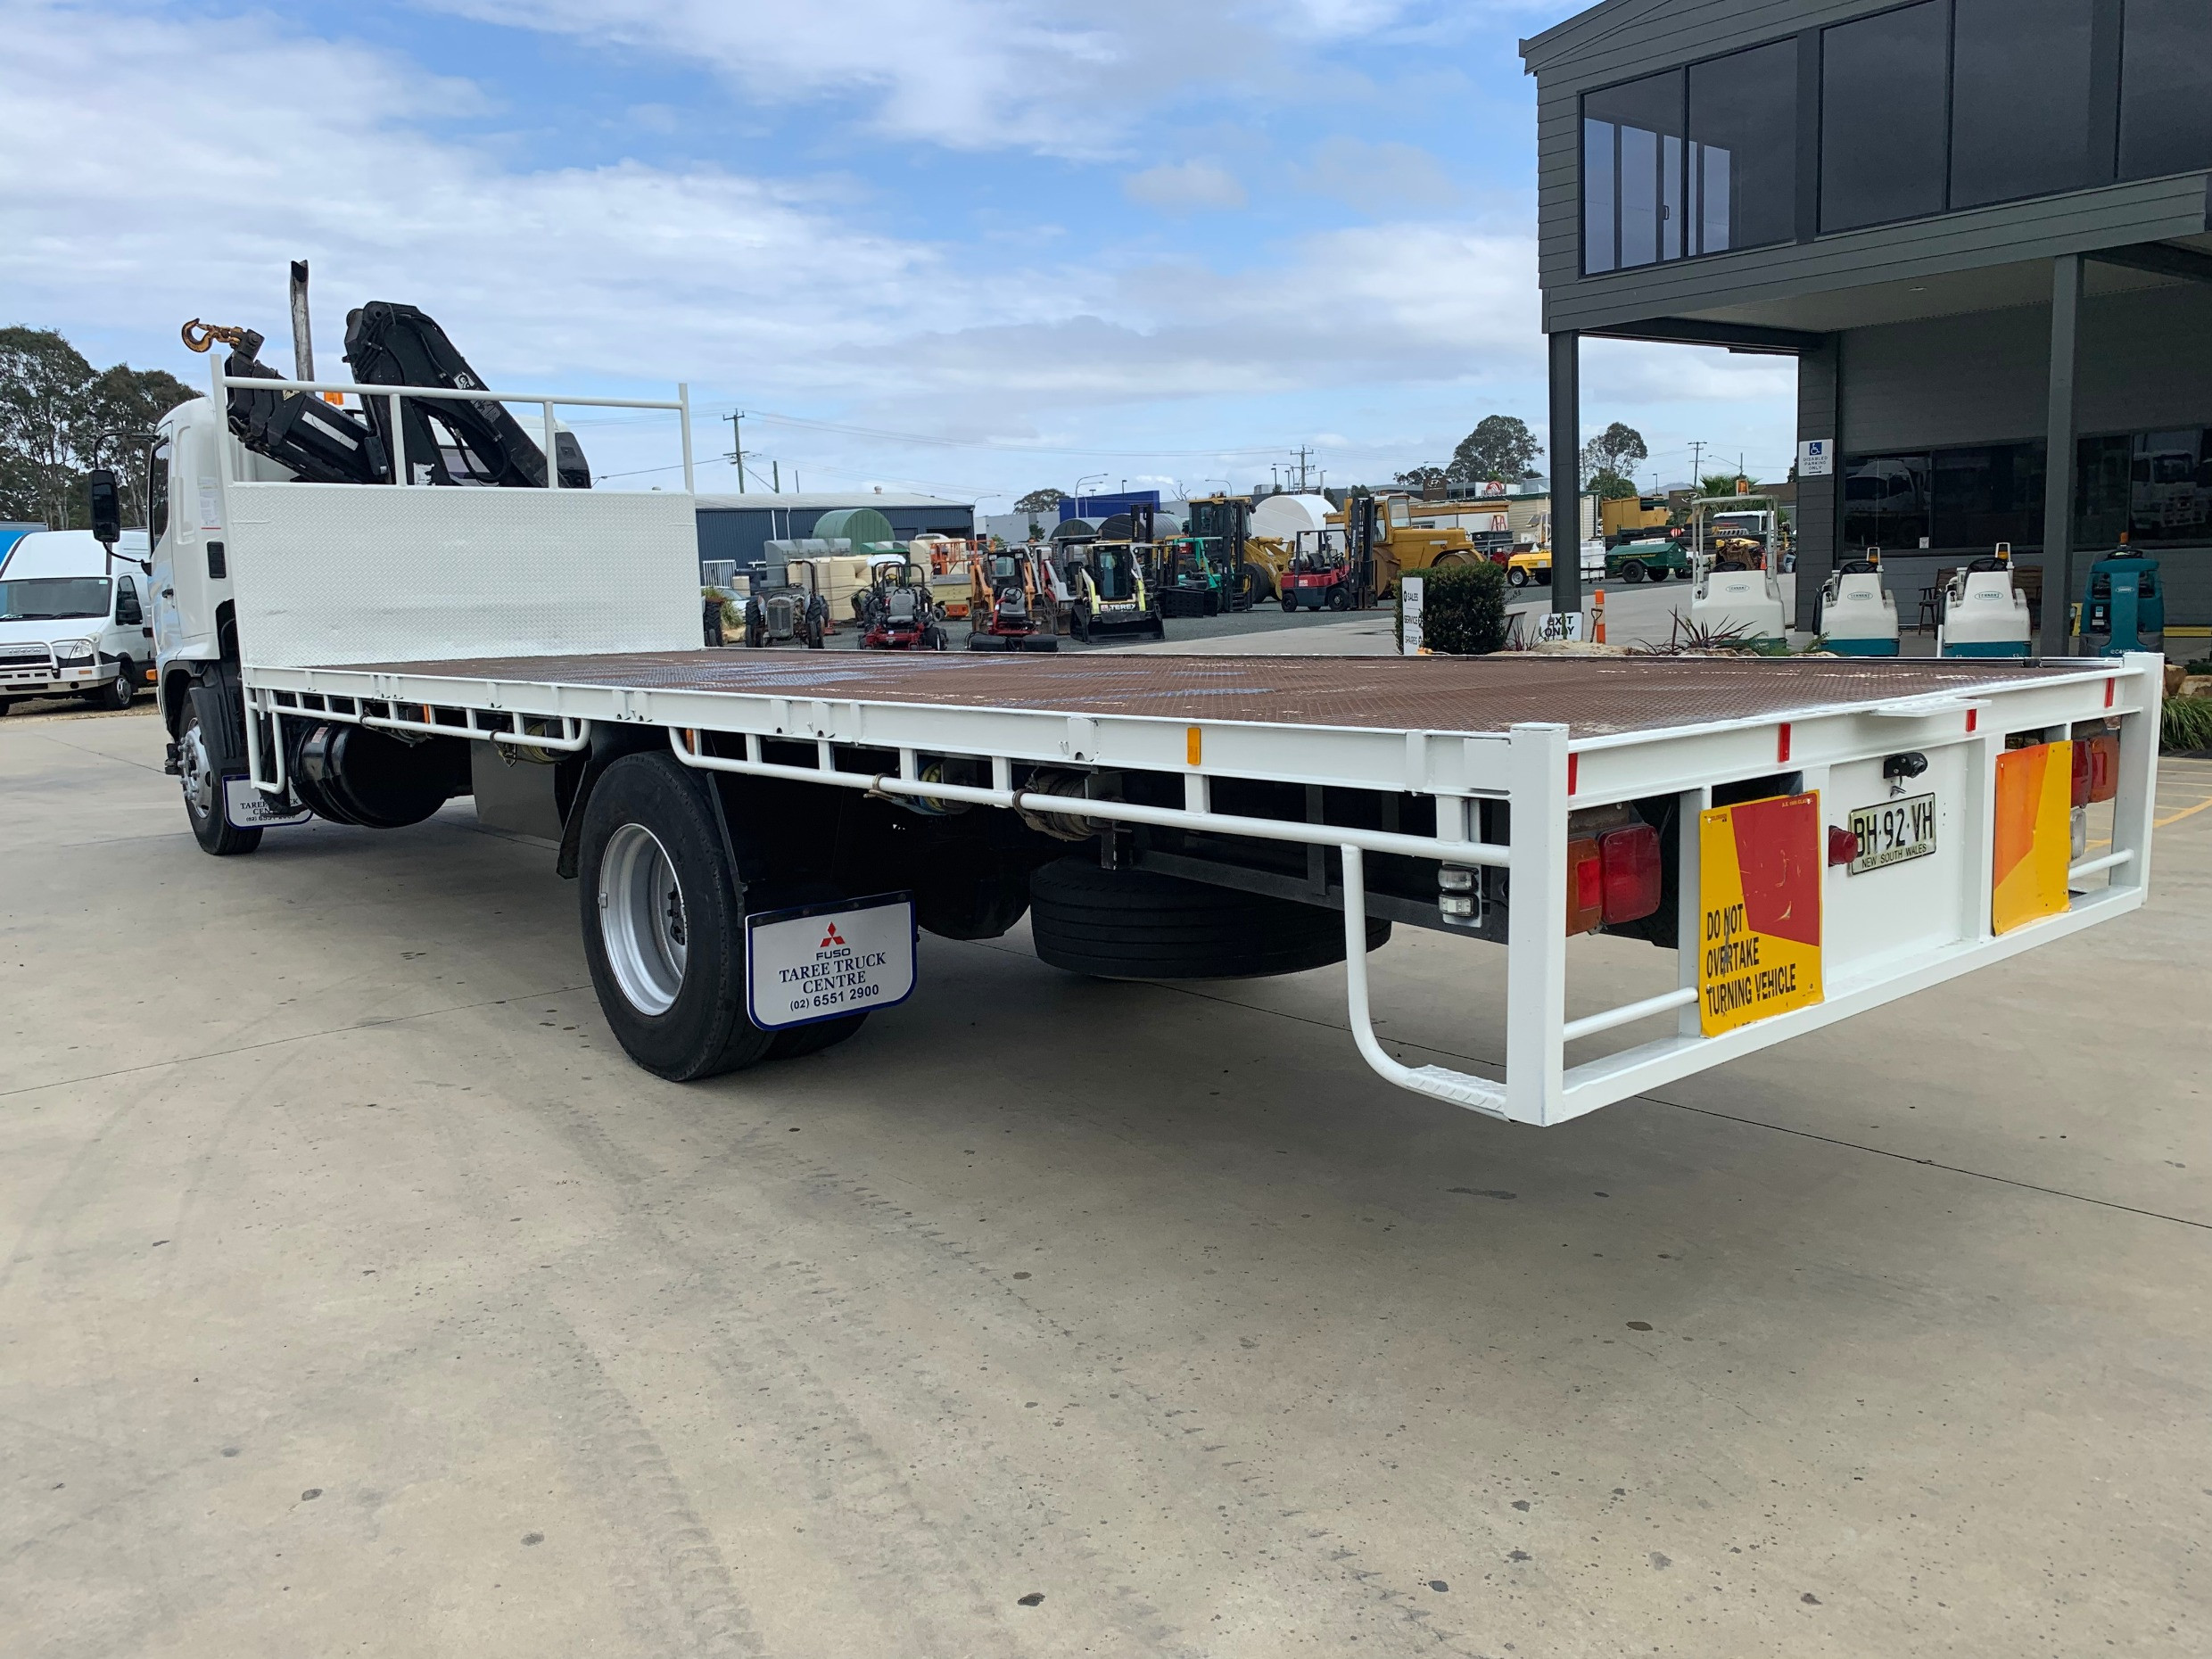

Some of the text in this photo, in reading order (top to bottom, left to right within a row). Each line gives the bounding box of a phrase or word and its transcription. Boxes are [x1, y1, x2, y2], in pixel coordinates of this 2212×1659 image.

[1407, 592, 1418, 601] SALES
[1109, 603, 1136, 611] TEREX
[1404, 615, 1418, 624] SERVICE
[1548, 615, 1573, 625] XT
[1405, 635, 1417, 645] SPARES
[1545, 626, 1574, 637] ONY
[1861, 843, 1927, 869] NEW SOUTH WALES
[1707, 904, 1744, 941] DO NOT
[816, 947, 851, 961] FUSO
[1707, 937, 1759, 978] OVERTAKE
[779, 952, 886, 983] TAREE TRUCK
[803, 970, 866, 994] CENTRE
[1706, 963, 1796, 1017] TURNING VEHICLE
[789, 984, 879, 1011] (02) 6551 2900
